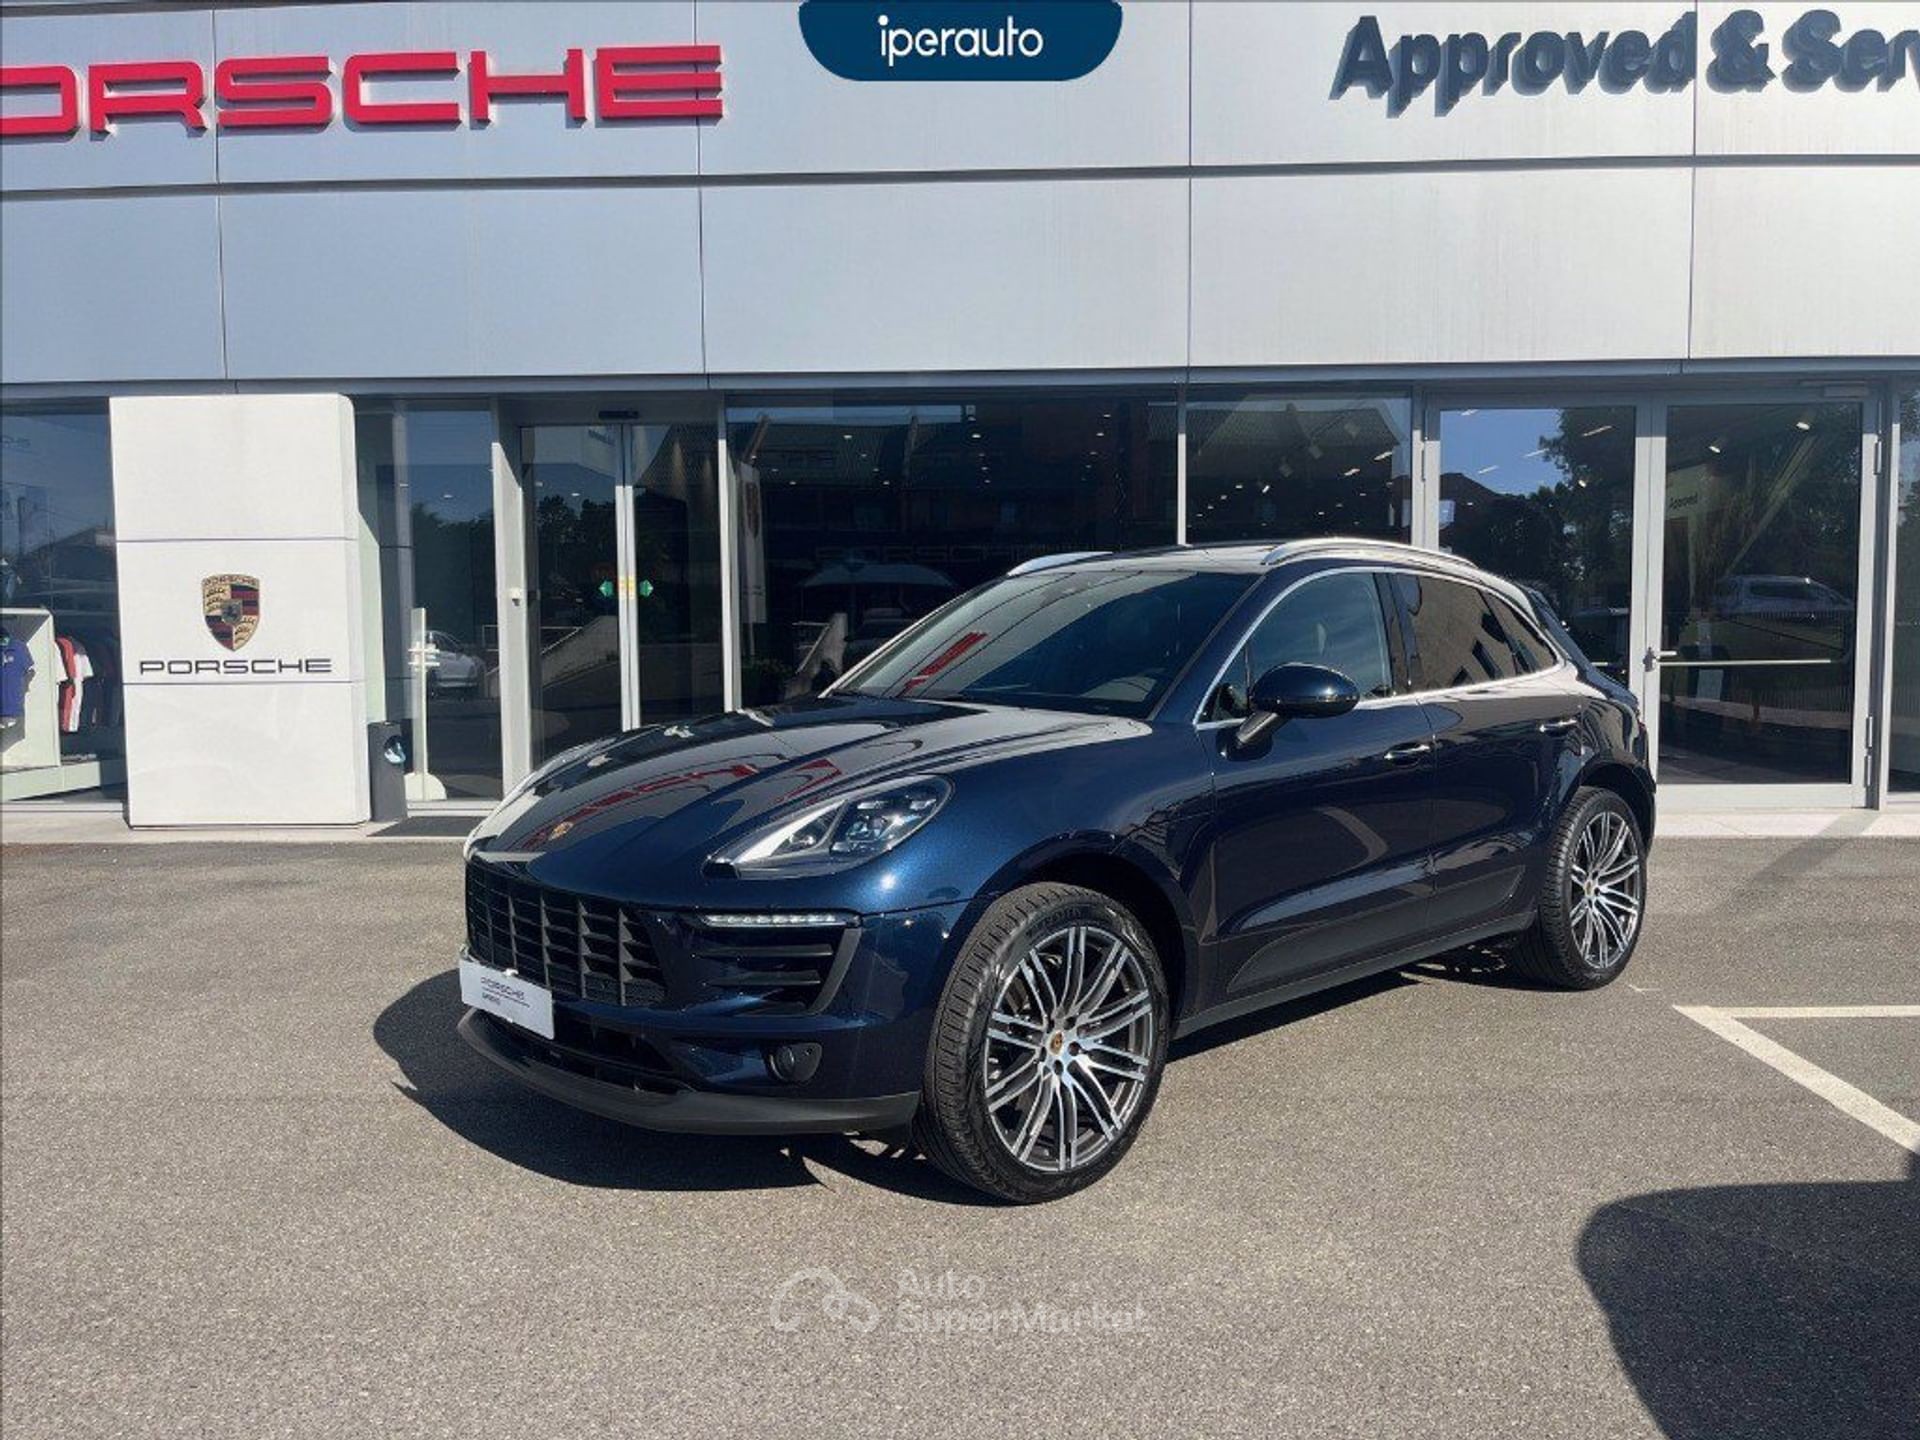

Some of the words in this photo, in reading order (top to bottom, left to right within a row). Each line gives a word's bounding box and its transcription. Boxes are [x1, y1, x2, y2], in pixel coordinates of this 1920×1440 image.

[1329, 11, 1698, 118] Approved
[1706, 9, 1776, 93] &
[1782, 9, 1920, 93] Ser
[140, 659, 332, 675] PORSCHE
